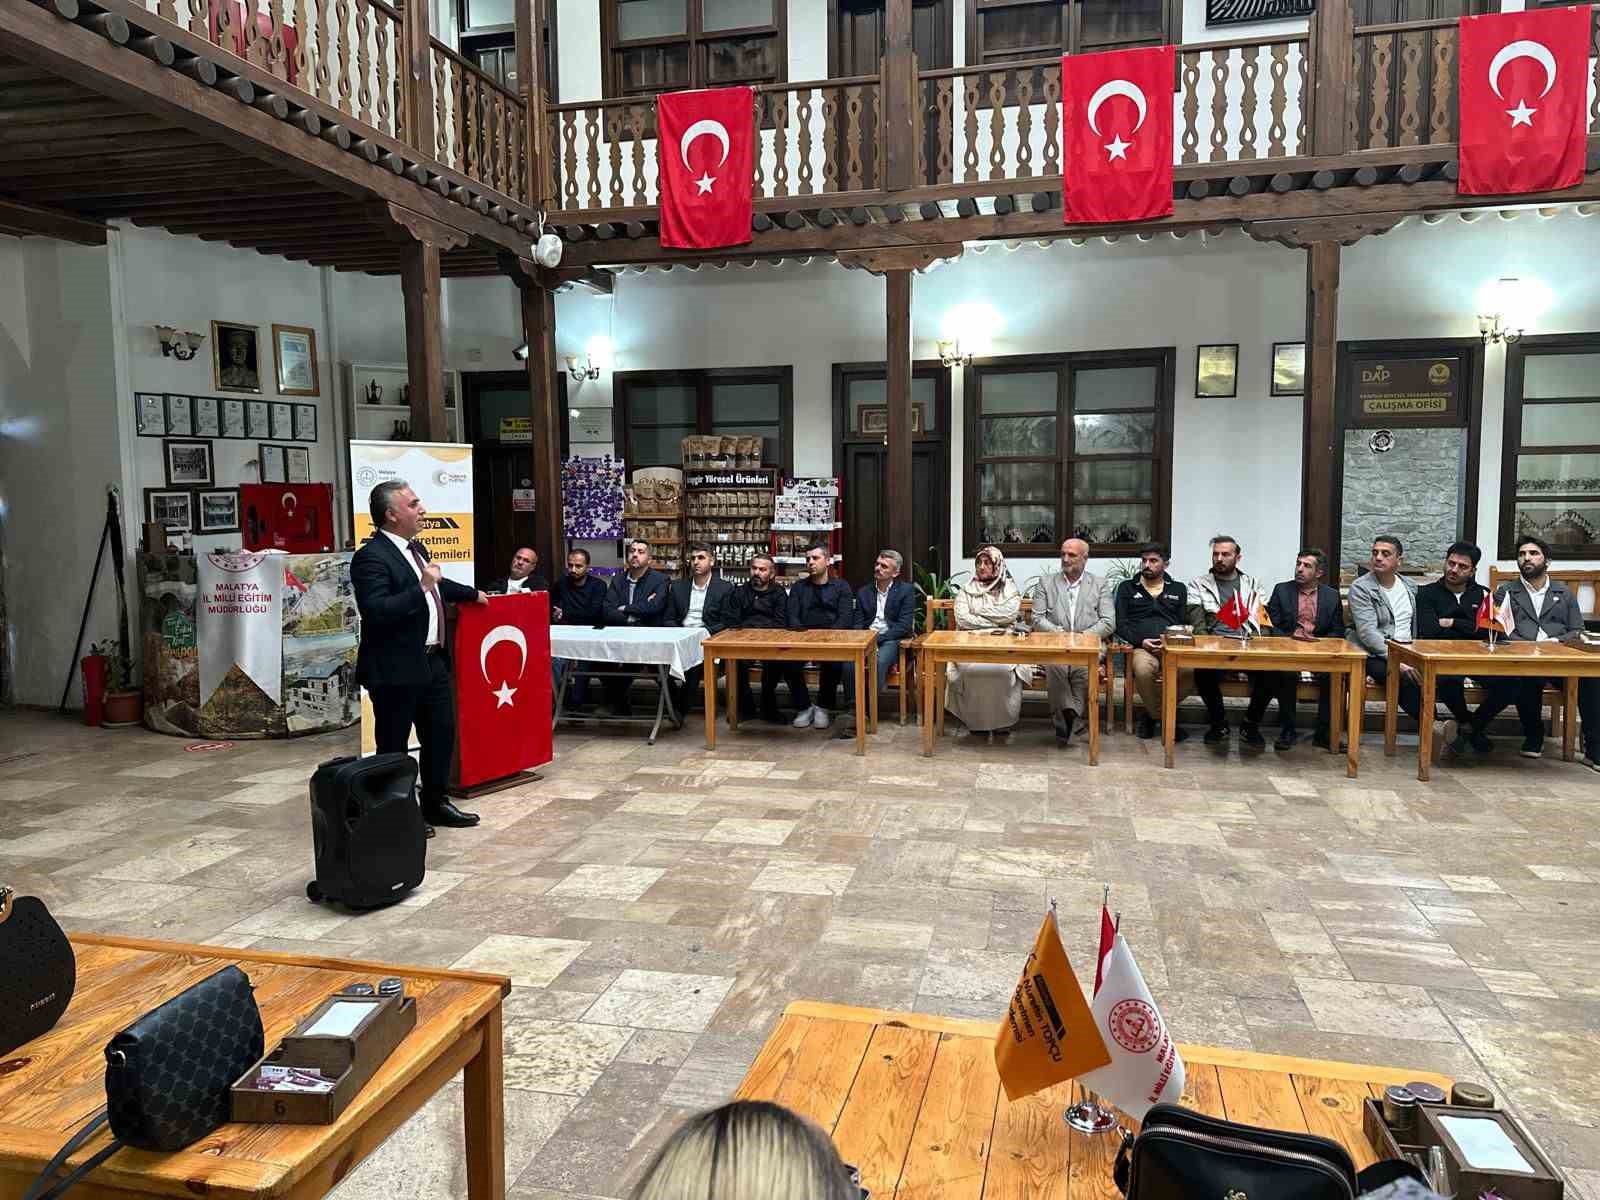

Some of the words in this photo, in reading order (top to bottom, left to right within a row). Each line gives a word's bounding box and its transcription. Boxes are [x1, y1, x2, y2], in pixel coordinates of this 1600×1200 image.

[705, 475, 733, 484] Yöresel
[735, 473, 769, 485] Ürünleri
[422, 520, 441, 529] atya
[418, 536, 459, 545] retmen
[430, 549, 471, 560] demileri
[215, 583, 259, 592] MALATYA
[238, 592, 272, 602] EĞİTİM
